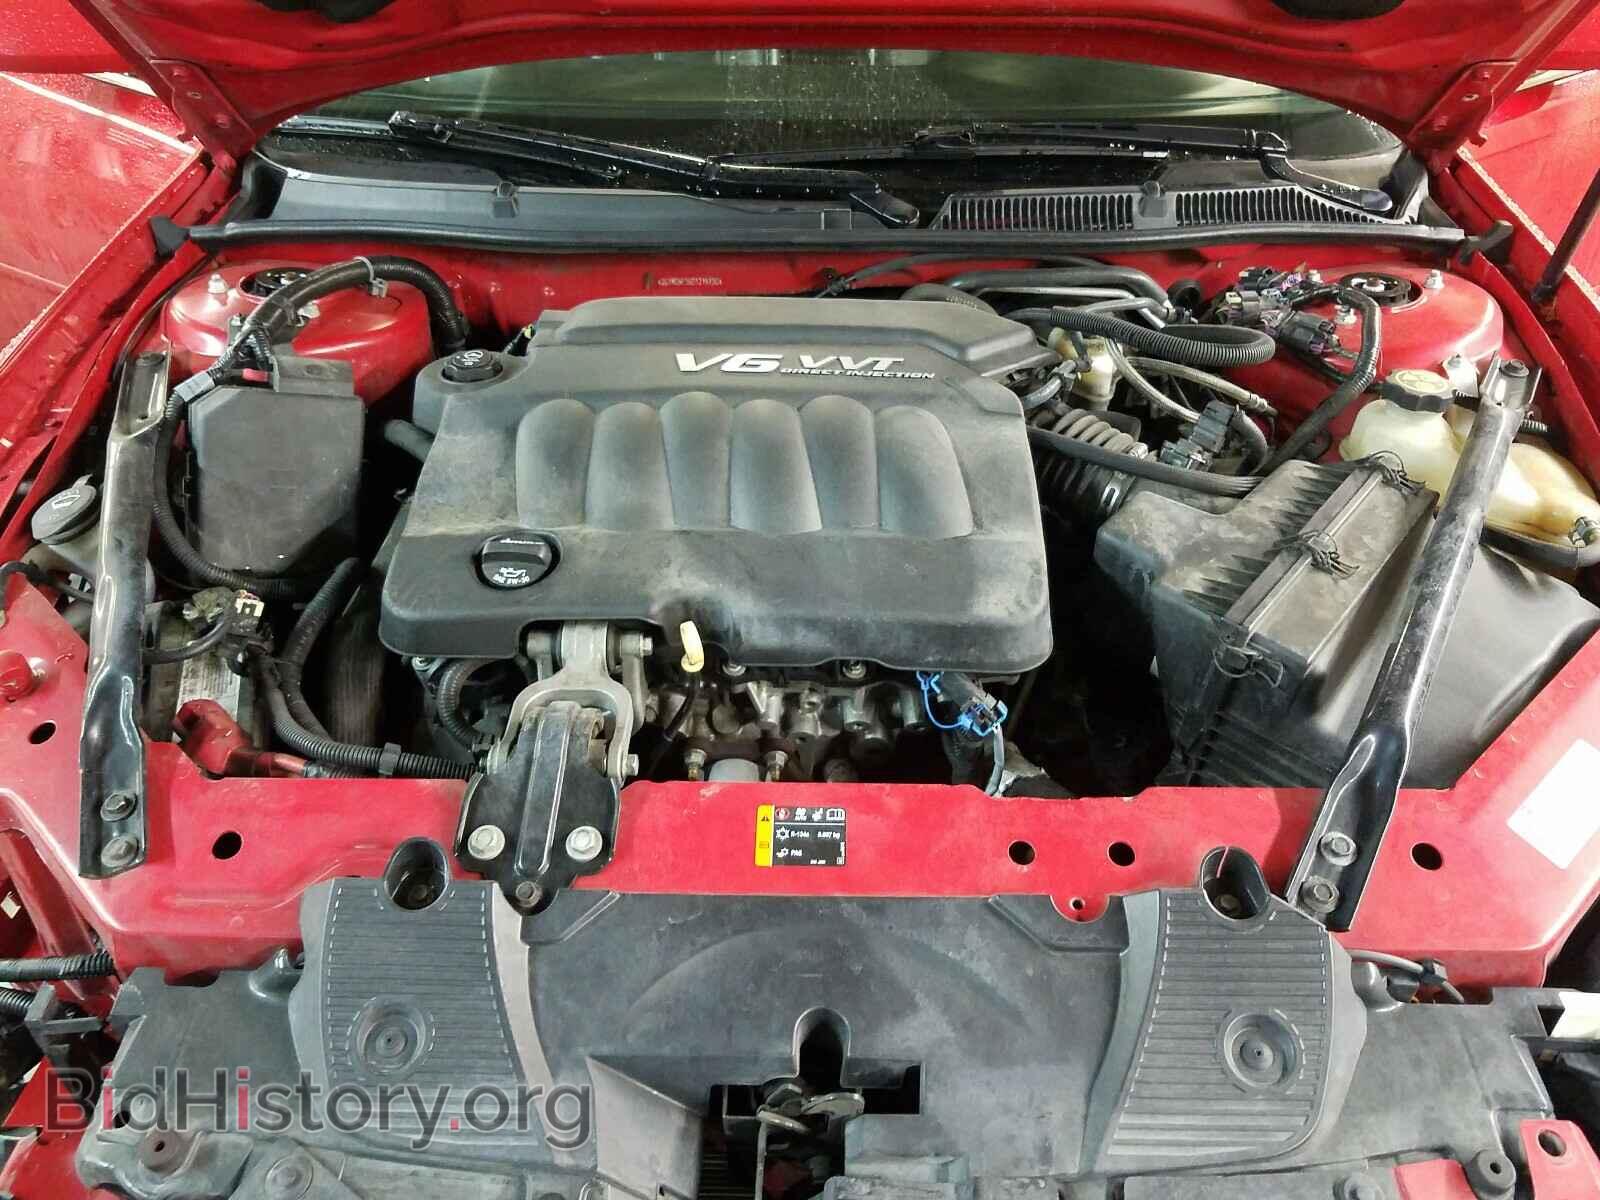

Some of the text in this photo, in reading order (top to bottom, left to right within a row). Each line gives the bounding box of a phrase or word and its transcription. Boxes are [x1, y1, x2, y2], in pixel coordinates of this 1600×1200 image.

[675, 353, 904, 373] V6 VVT
[780, 367, 935, 379] DIRECT INJECTION
